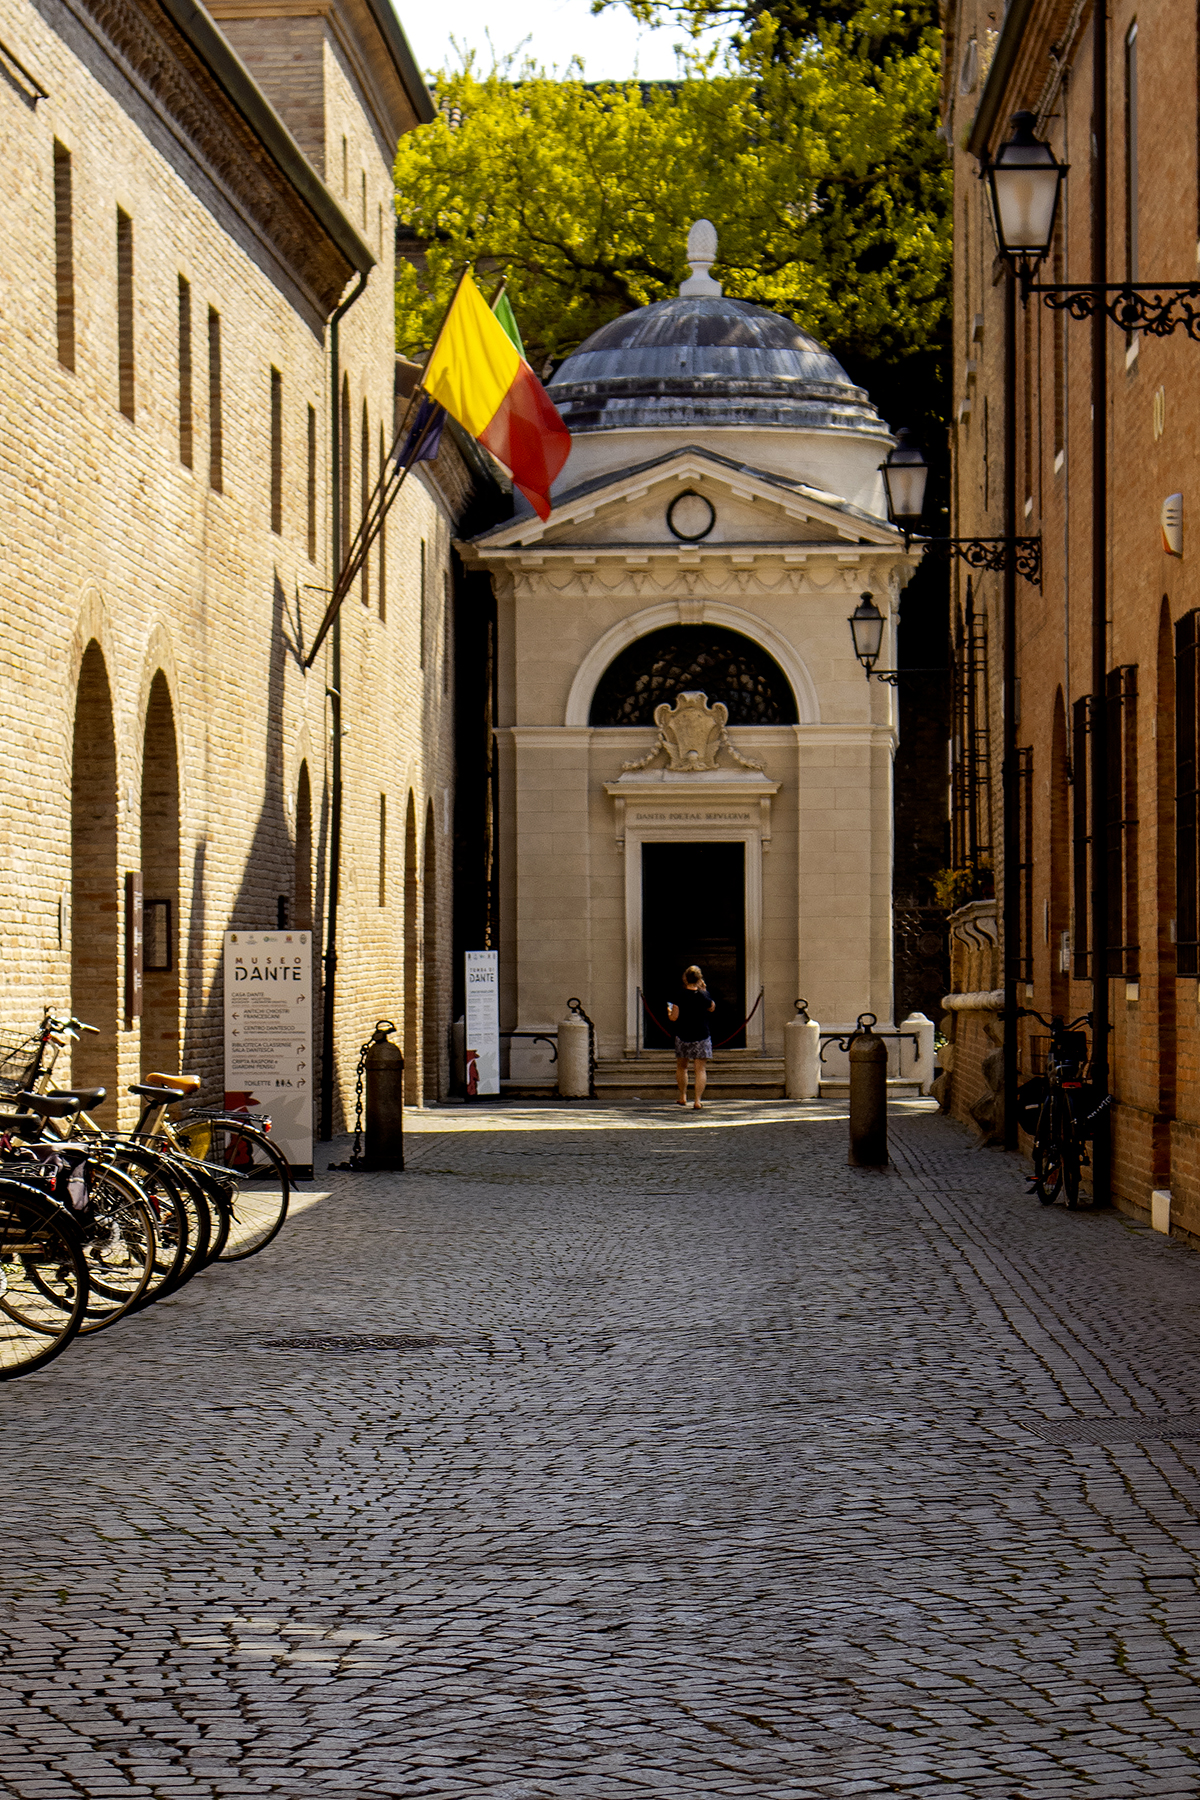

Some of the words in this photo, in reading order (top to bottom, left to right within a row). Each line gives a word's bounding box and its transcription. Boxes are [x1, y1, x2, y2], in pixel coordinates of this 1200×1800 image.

[235, 956, 301, 964] MUSEO
[235, 966, 301, 981] DANTE
[470, 973, 494, 982] DANTE
